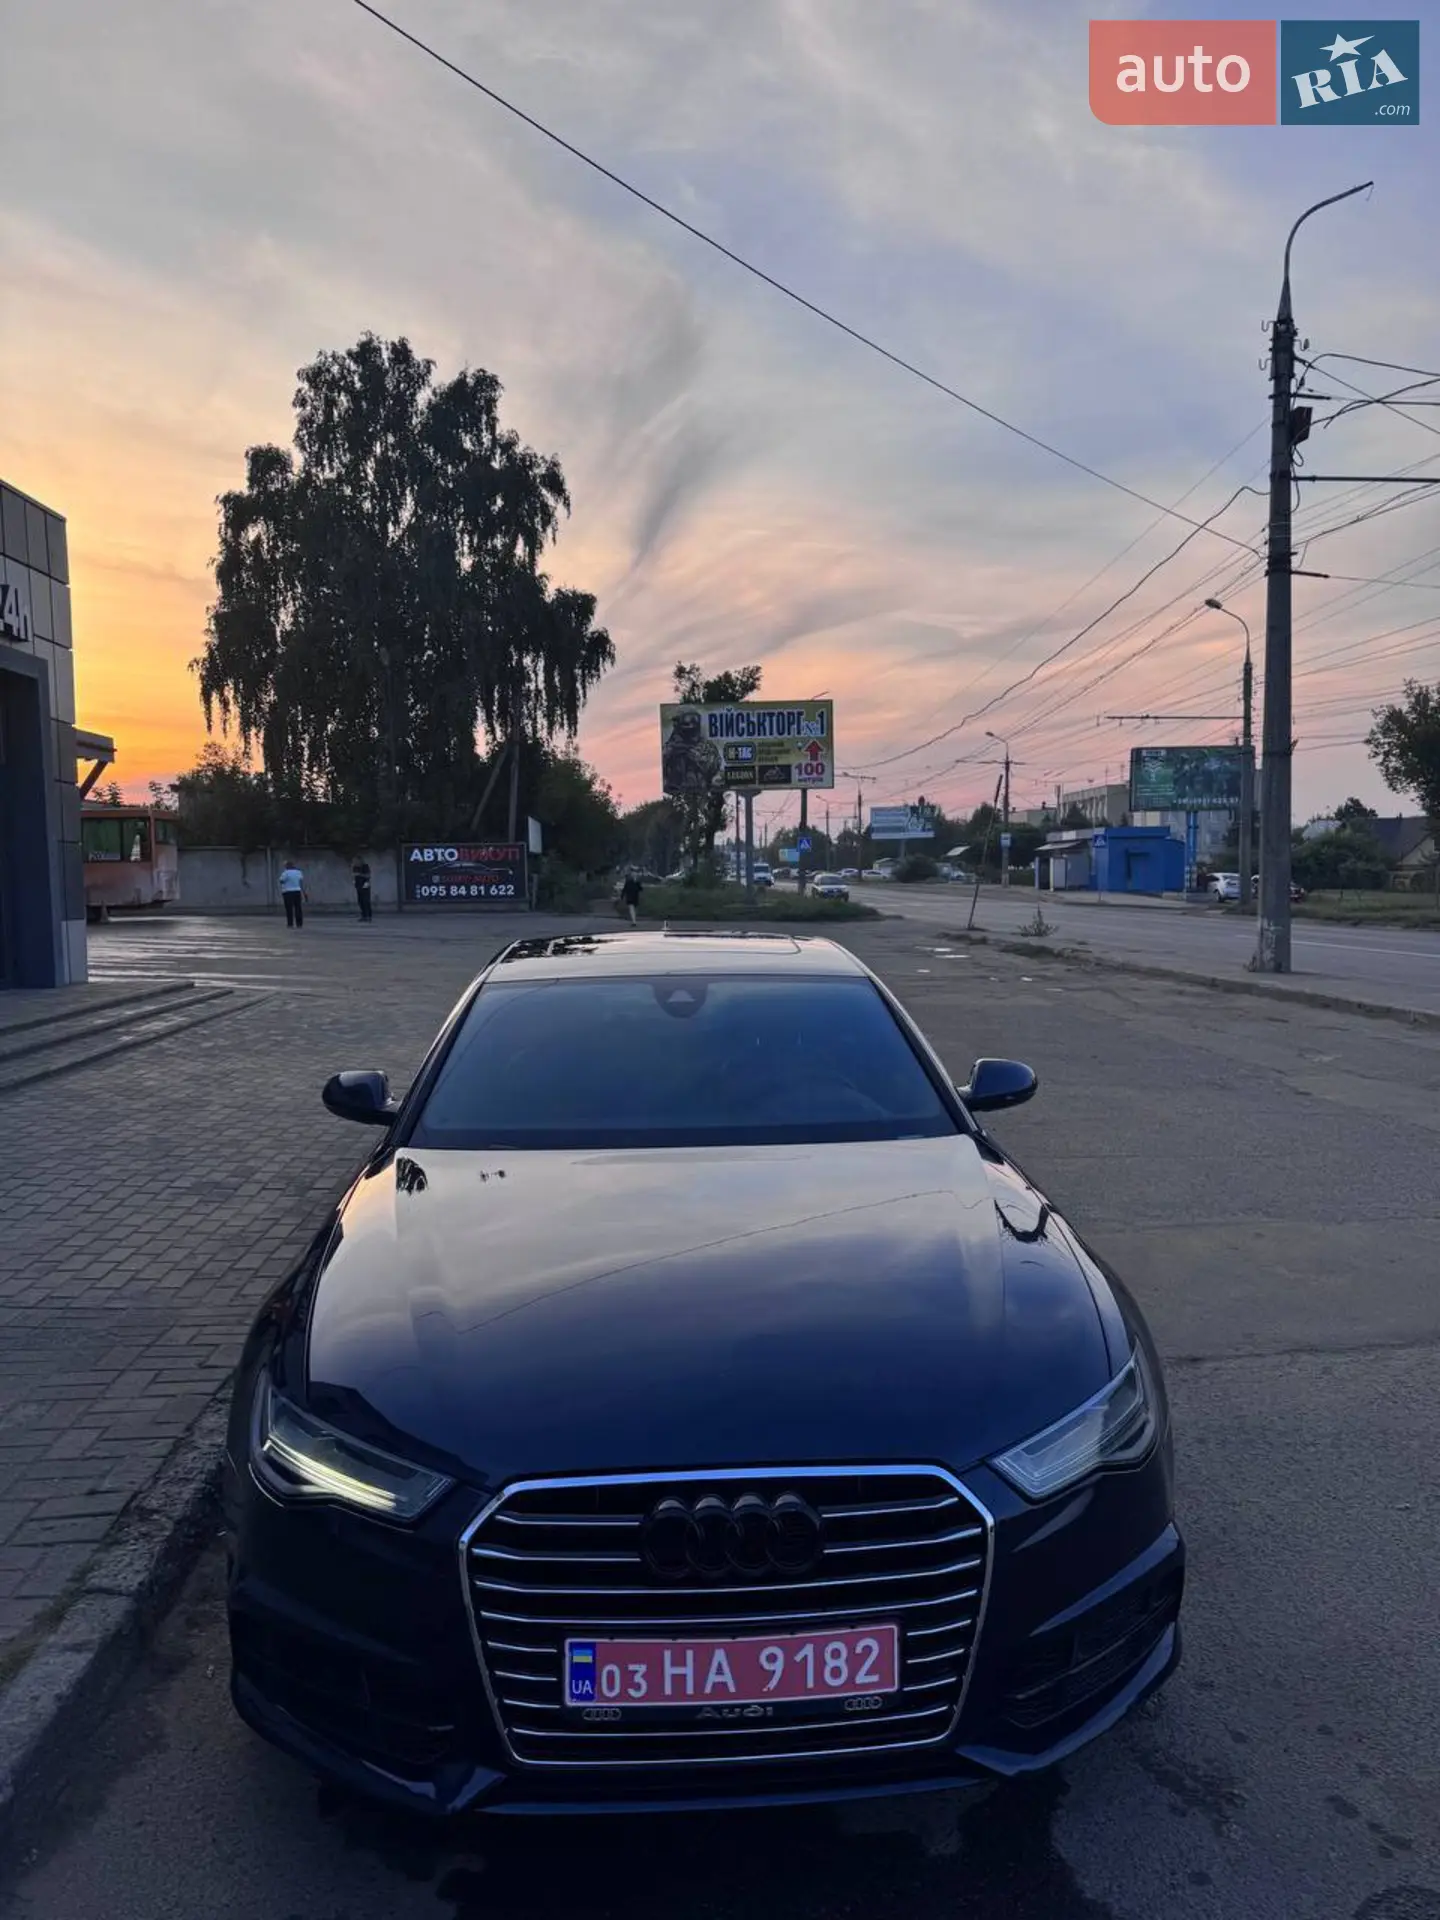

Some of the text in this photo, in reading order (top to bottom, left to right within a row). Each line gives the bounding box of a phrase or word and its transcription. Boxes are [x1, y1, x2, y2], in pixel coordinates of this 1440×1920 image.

[0, 584, 33, 642] 4h
[708, 708, 804, 738] ВІЙСЬКТОРГ
[795, 762, 825, 776] 100
[421, 884, 515, 897] 095 84 81 622
[600, 1663, 648, 1699] 03
[759, 1637, 880, 1692] 9182
[571, 1679, 593, 1695] UA
